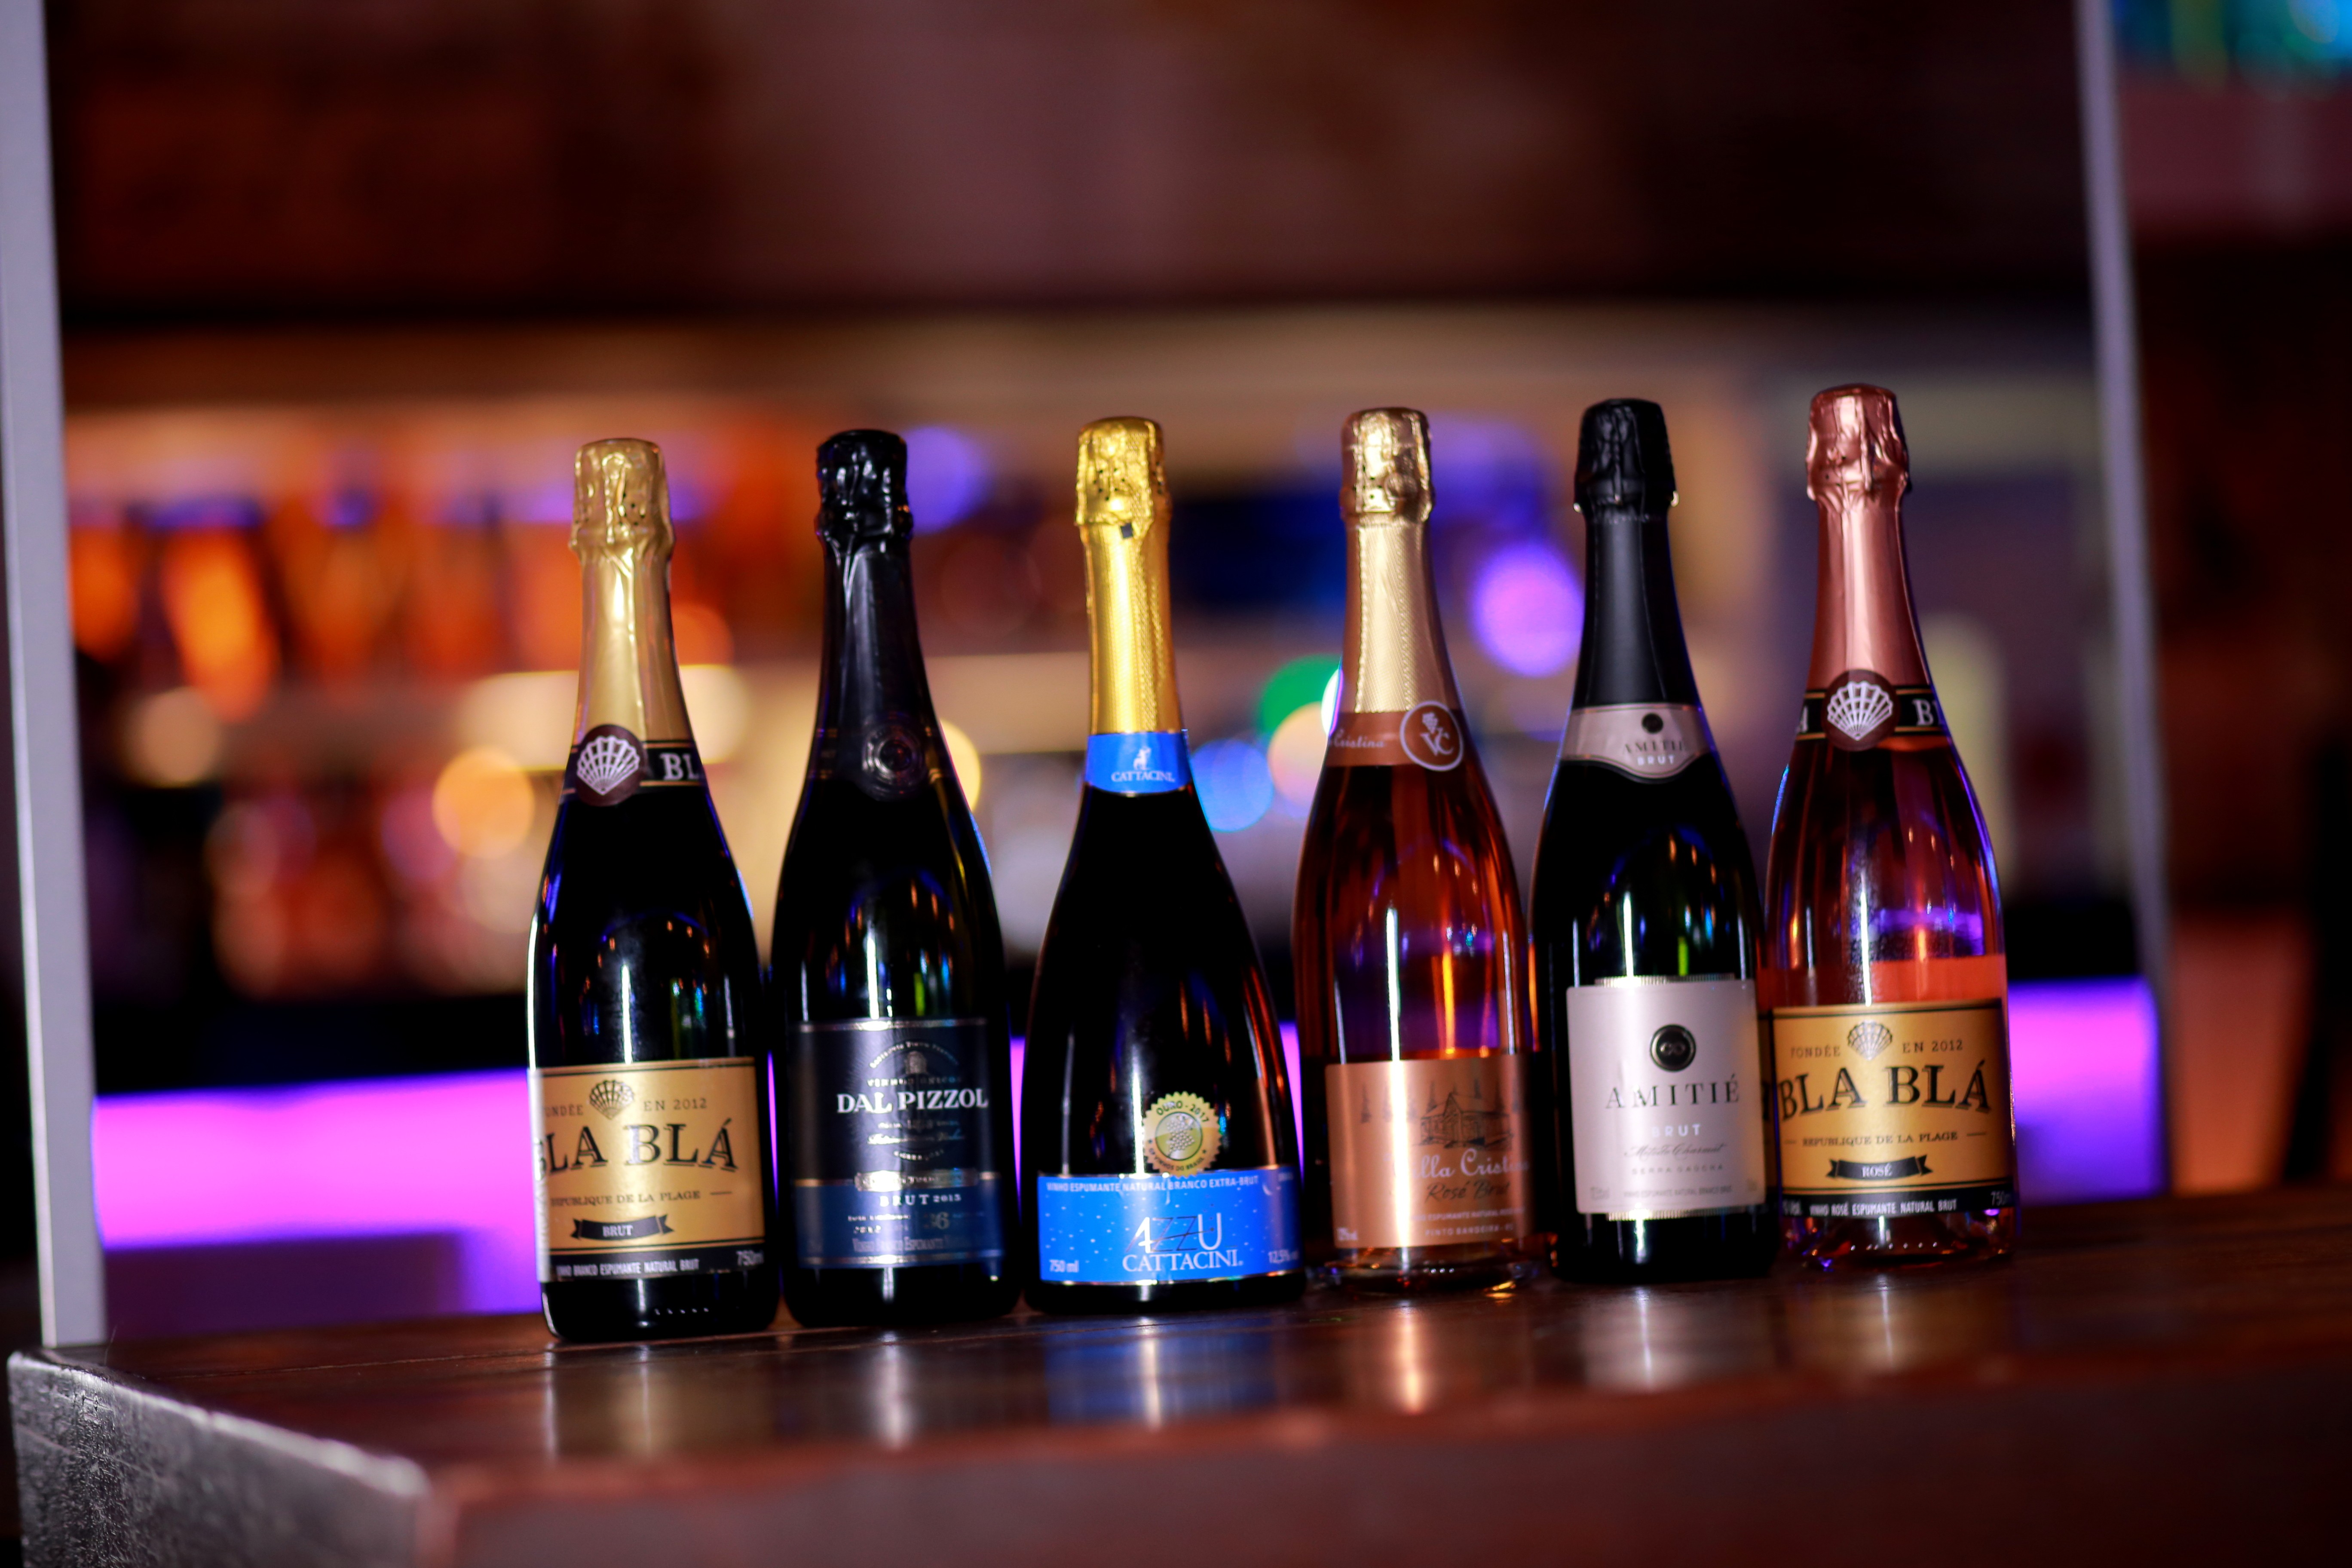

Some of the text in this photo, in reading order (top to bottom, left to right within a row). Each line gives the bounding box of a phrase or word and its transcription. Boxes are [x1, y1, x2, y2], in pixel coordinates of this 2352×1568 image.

[1637, 754, 1675, 766] BRUT
[1902, 1041, 1924, 1054] EN
[1932, 1039, 1963, 1053] 2012
[1605, 1074, 1739, 1109] AMITIÉ
[1779, 1059, 1992, 1123] BLA BLÁ
[643, 1100, 666, 1112] EN
[673, 1098, 707, 1111] 2012
[836, 1088, 988, 1114] DAL PIZZOL
[1156, 1100, 1182, 1115] OURO
[1652, 1123, 1701, 1137] BRUT
[624, 1118, 738, 1172] BLÁ
[1876, 1136, 1893, 1145] DE
[1897, 1133, 1914, 1143] LA
[1919, 1131, 1958, 1142] PLAGE
[1862, 1164, 1892, 1178] ROSÉ
[1069, 1181, 1119, 1193] ESPUMANTE
[1121, 1180, 1167, 1192] NATURAL
[1167, 1179, 1207, 1191] BRANCO
[1209, 1175, 1259, 1189] EXTRA-BRUT
[616, 1194, 634, 1204] DE
[638, 1193, 654, 1202] LA
[659, 1190, 701, 1202] PLAGE
[879, 1194, 929, 1207] BRUT
[1852, 1201, 1896, 1216] ESPUMANTE
[1900, 1200, 1935, 1213] NATURAL
[1938, 1198, 1957, 1211] BRUT
[602, 1225, 634, 1237] BRUT
[600, 1261, 642, 1275] ESPUMANTE
[643, 1260, 678, 1273] NATURAL
[1049, 1259, 1079, 1273] 750 ml
